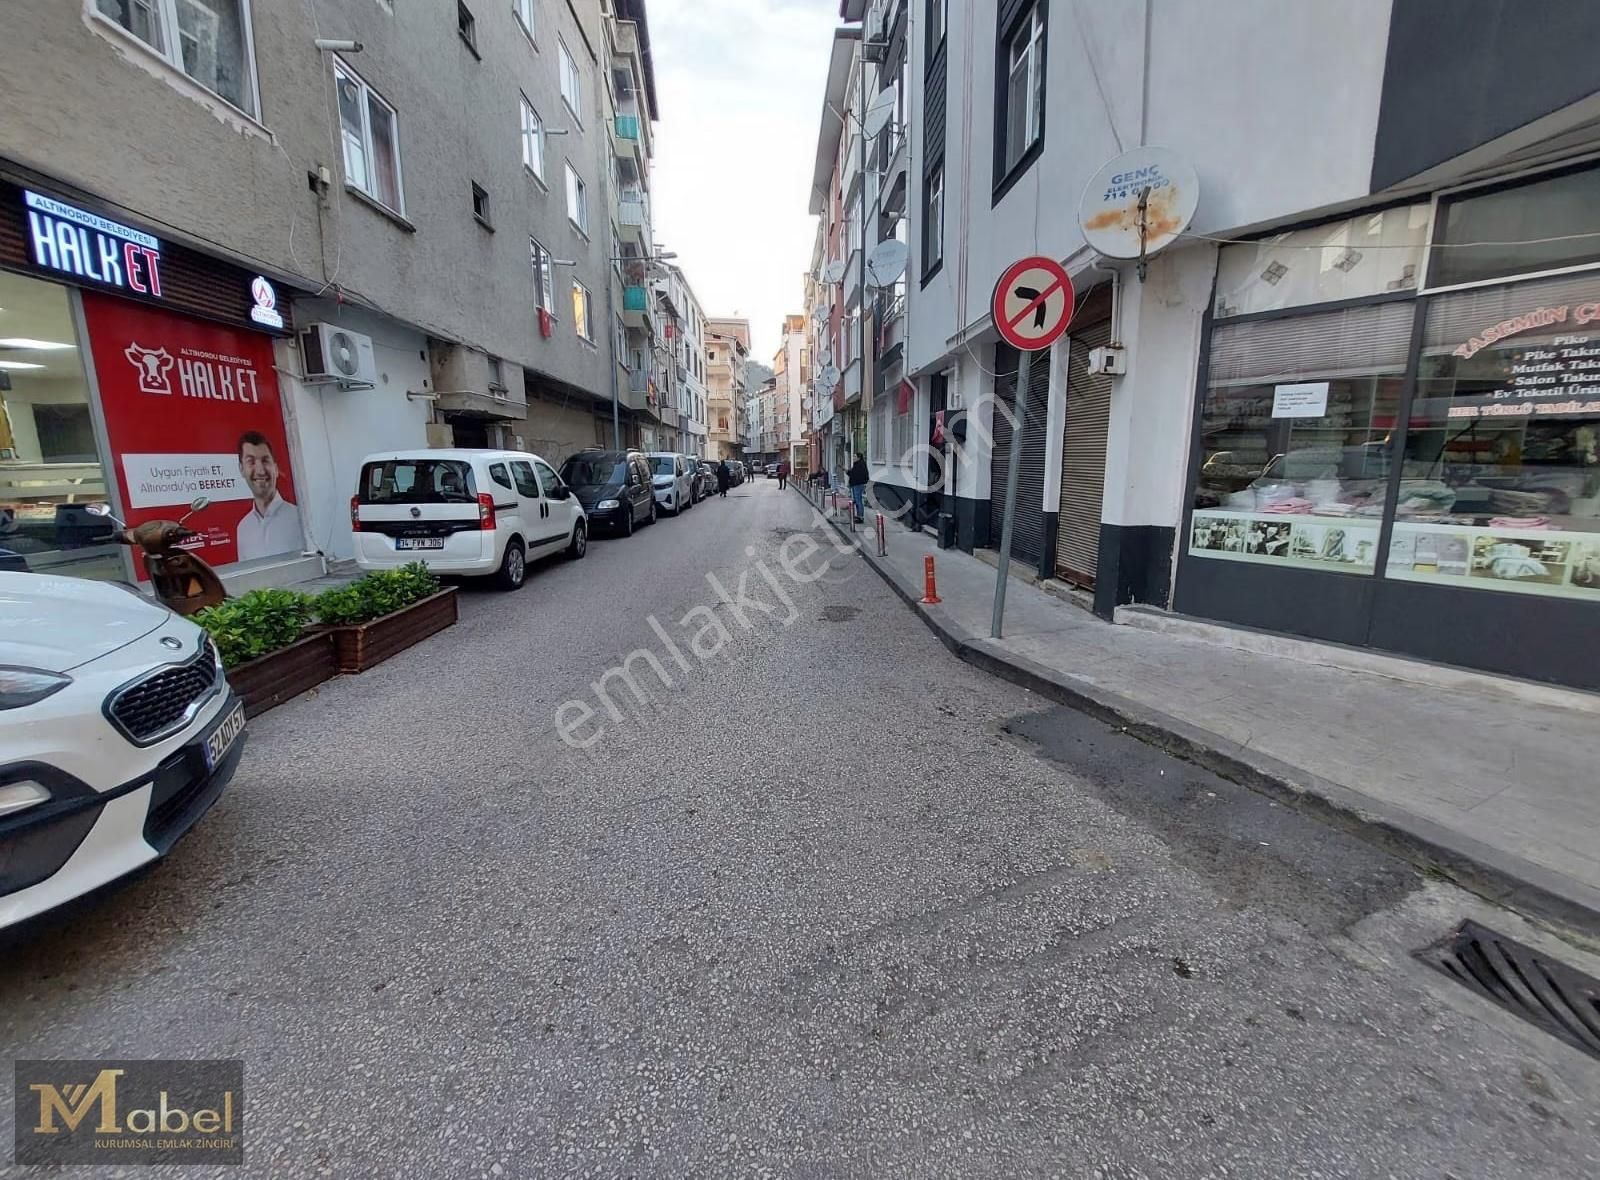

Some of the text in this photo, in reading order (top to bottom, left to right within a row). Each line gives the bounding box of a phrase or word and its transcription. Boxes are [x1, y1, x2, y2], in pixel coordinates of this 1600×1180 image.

[35, 197, 152, 245] ALTINORDU BELEDİYESİ
[28, 210, 161, 296] HALK ET
[1452, 304, 1568, 359] YASEMİN
[1553, 336, 1589, 346] Piko
[1523, 351, 1557, 361] Pike
[1511, 362, 1565, 374] Mutfak
[177, 358, 258, 403] HALK ET
[1514, 376, 1556, 386] Salon
[1493, 383, 1600, 399] Ev Tekstil Ürü
[1448, 406, 1479, 417] HER
[1480, 402, 1534, 416] TÜRLÜ
[150, 467, 182, 481] Uygun
[211, 465, 224, 476] ET,
[140, 479, 236, 494] Altınordu'ya BEREKET
